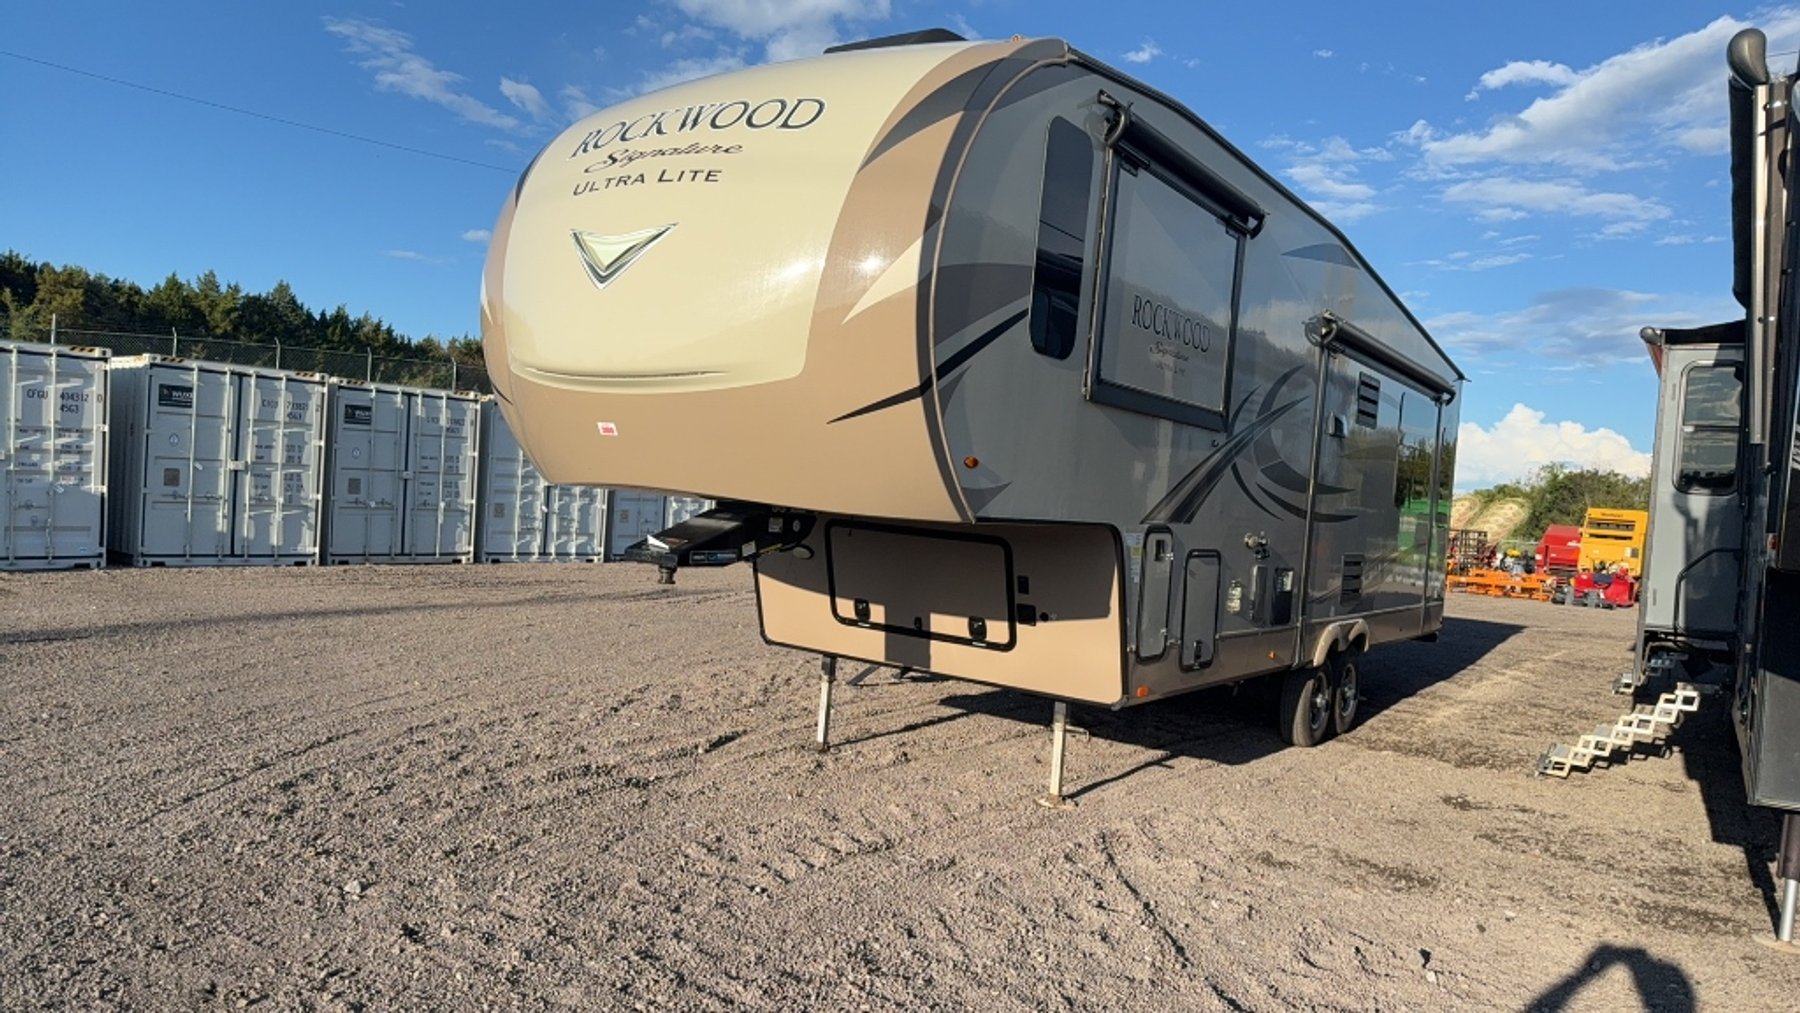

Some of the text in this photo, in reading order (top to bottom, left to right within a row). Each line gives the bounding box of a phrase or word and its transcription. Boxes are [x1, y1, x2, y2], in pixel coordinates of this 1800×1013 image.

[568, 98, 825, 159] ROCKWOOD
[584, 142, 743, 174] Signature
[573, 168, 723, 196] ULTRA LITE
[1131, 294, 1211, 353] ROCKWOOD
